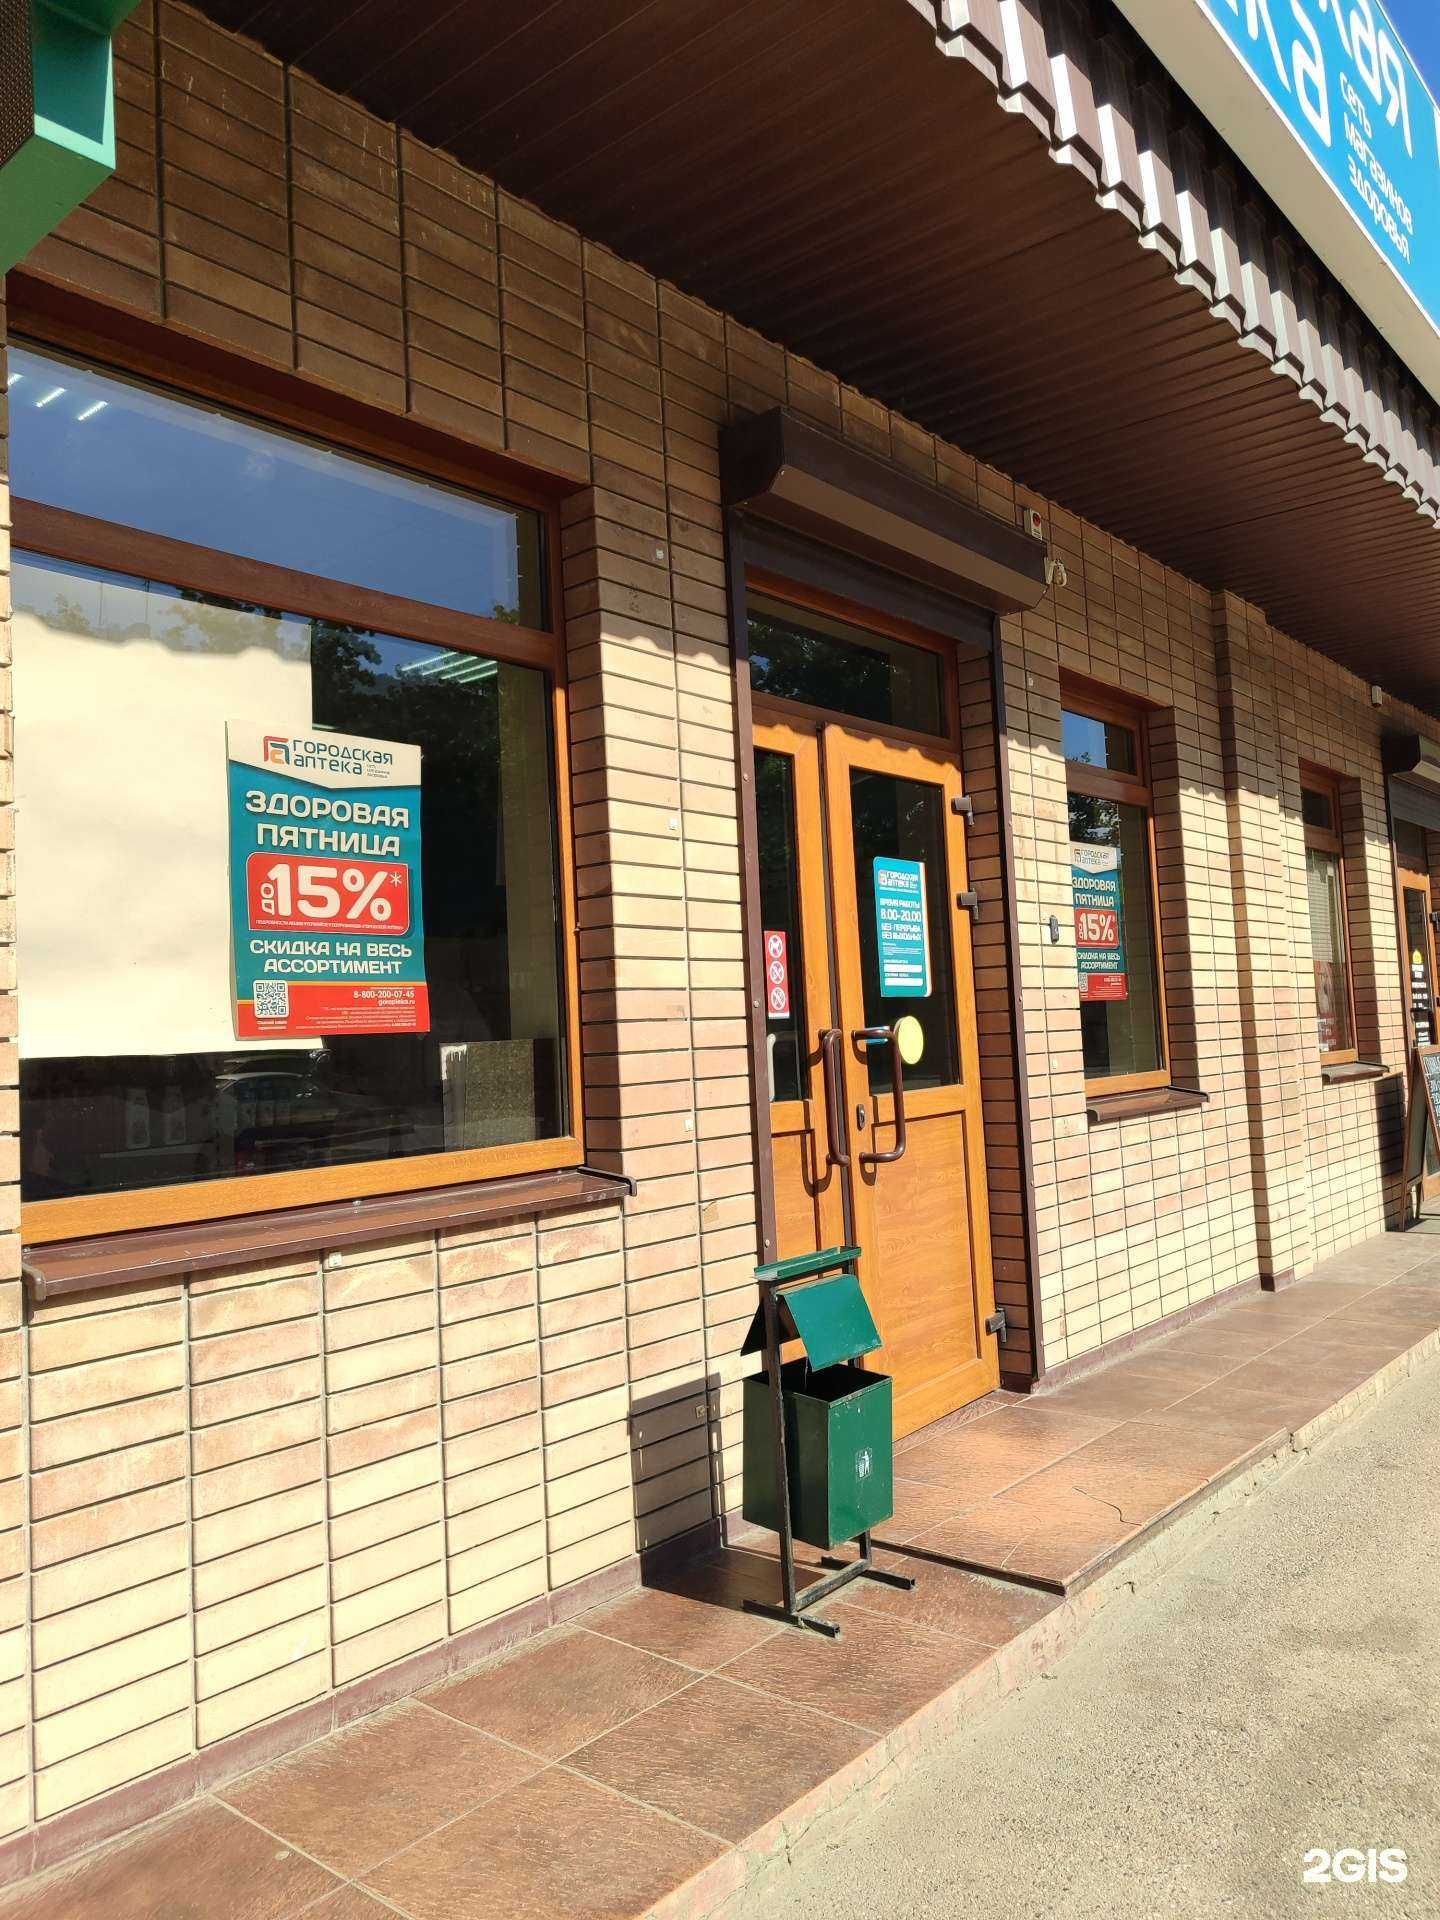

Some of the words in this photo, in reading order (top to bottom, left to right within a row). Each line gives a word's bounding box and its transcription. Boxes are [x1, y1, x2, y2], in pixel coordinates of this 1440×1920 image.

[245, 790, 409, 829] ЗДОРОВАЯ
[257, 822, 401, 857] ПЯТНИЦА
[1072, 876, 1116, 892] ЗДОРОВАЯ
[260, 882, 275, 916] ДО
[1075, 893, 1115, 907] ПЯТНИЦА
[249, 939, 330, 956] СКИДКА
[335, 941, 361, 957] НА
[366, 942, 412, 958] ВЕСЬ
[1077, 951, 1099, 960] СКИДКА
[1098, 952, 1107, 960] НА
[1107, 952, 1121, 961] ВЕСЬ
[263, 958, 403, 975] АССОРТИМЕНТ
[1080, 961, 1119, 970] АССОРТИМЕНТ
